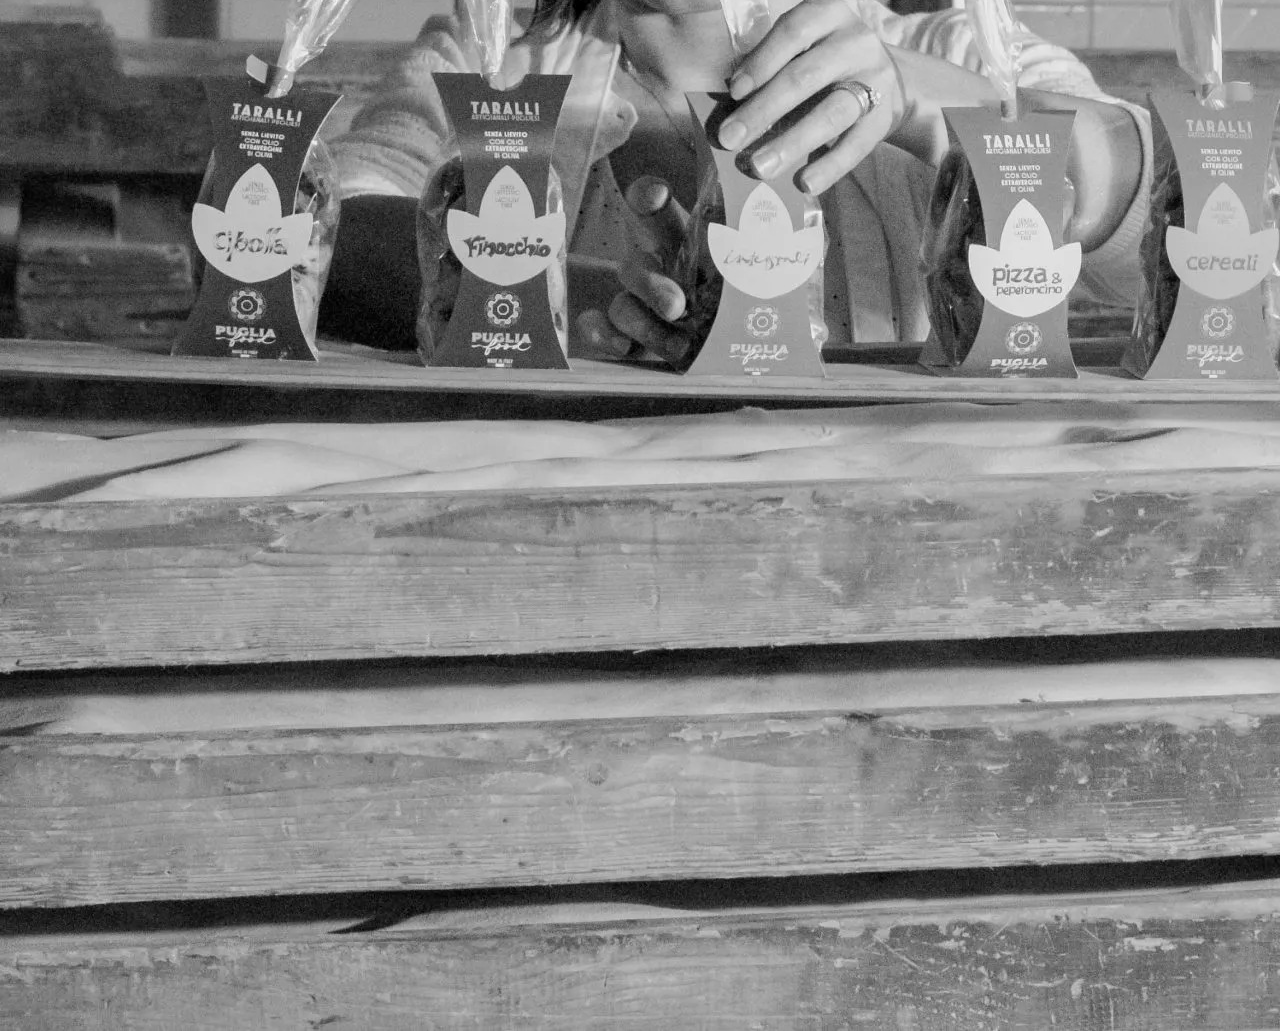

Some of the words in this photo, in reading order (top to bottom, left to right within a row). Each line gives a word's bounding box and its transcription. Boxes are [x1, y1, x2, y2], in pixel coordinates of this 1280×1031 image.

[233, 103, 302, 122] TARALLI
[470, 101, 540, 115] TARALLI
[1186, 120, 1252, 133] TARALLI
[983, 133, 1050, 148] TARALLI
[463, 235, 551, 258] Finocchio
[1186, 254, 1258, 272] cereali
[992, 264, 1048, 286] pizza
[1051, 273, 1062, 284] &
[996, 284, 1063, 296] peperoncino
[215, 325, 276, 338] PUGLIA
[471, 332, 532, 343] PUGLIA
[730, 344, 789, 354] PUGLIA
[1186, 344, 1244, 355] PUGLIA
[990, 358, 1048, 367] PUGLIA
